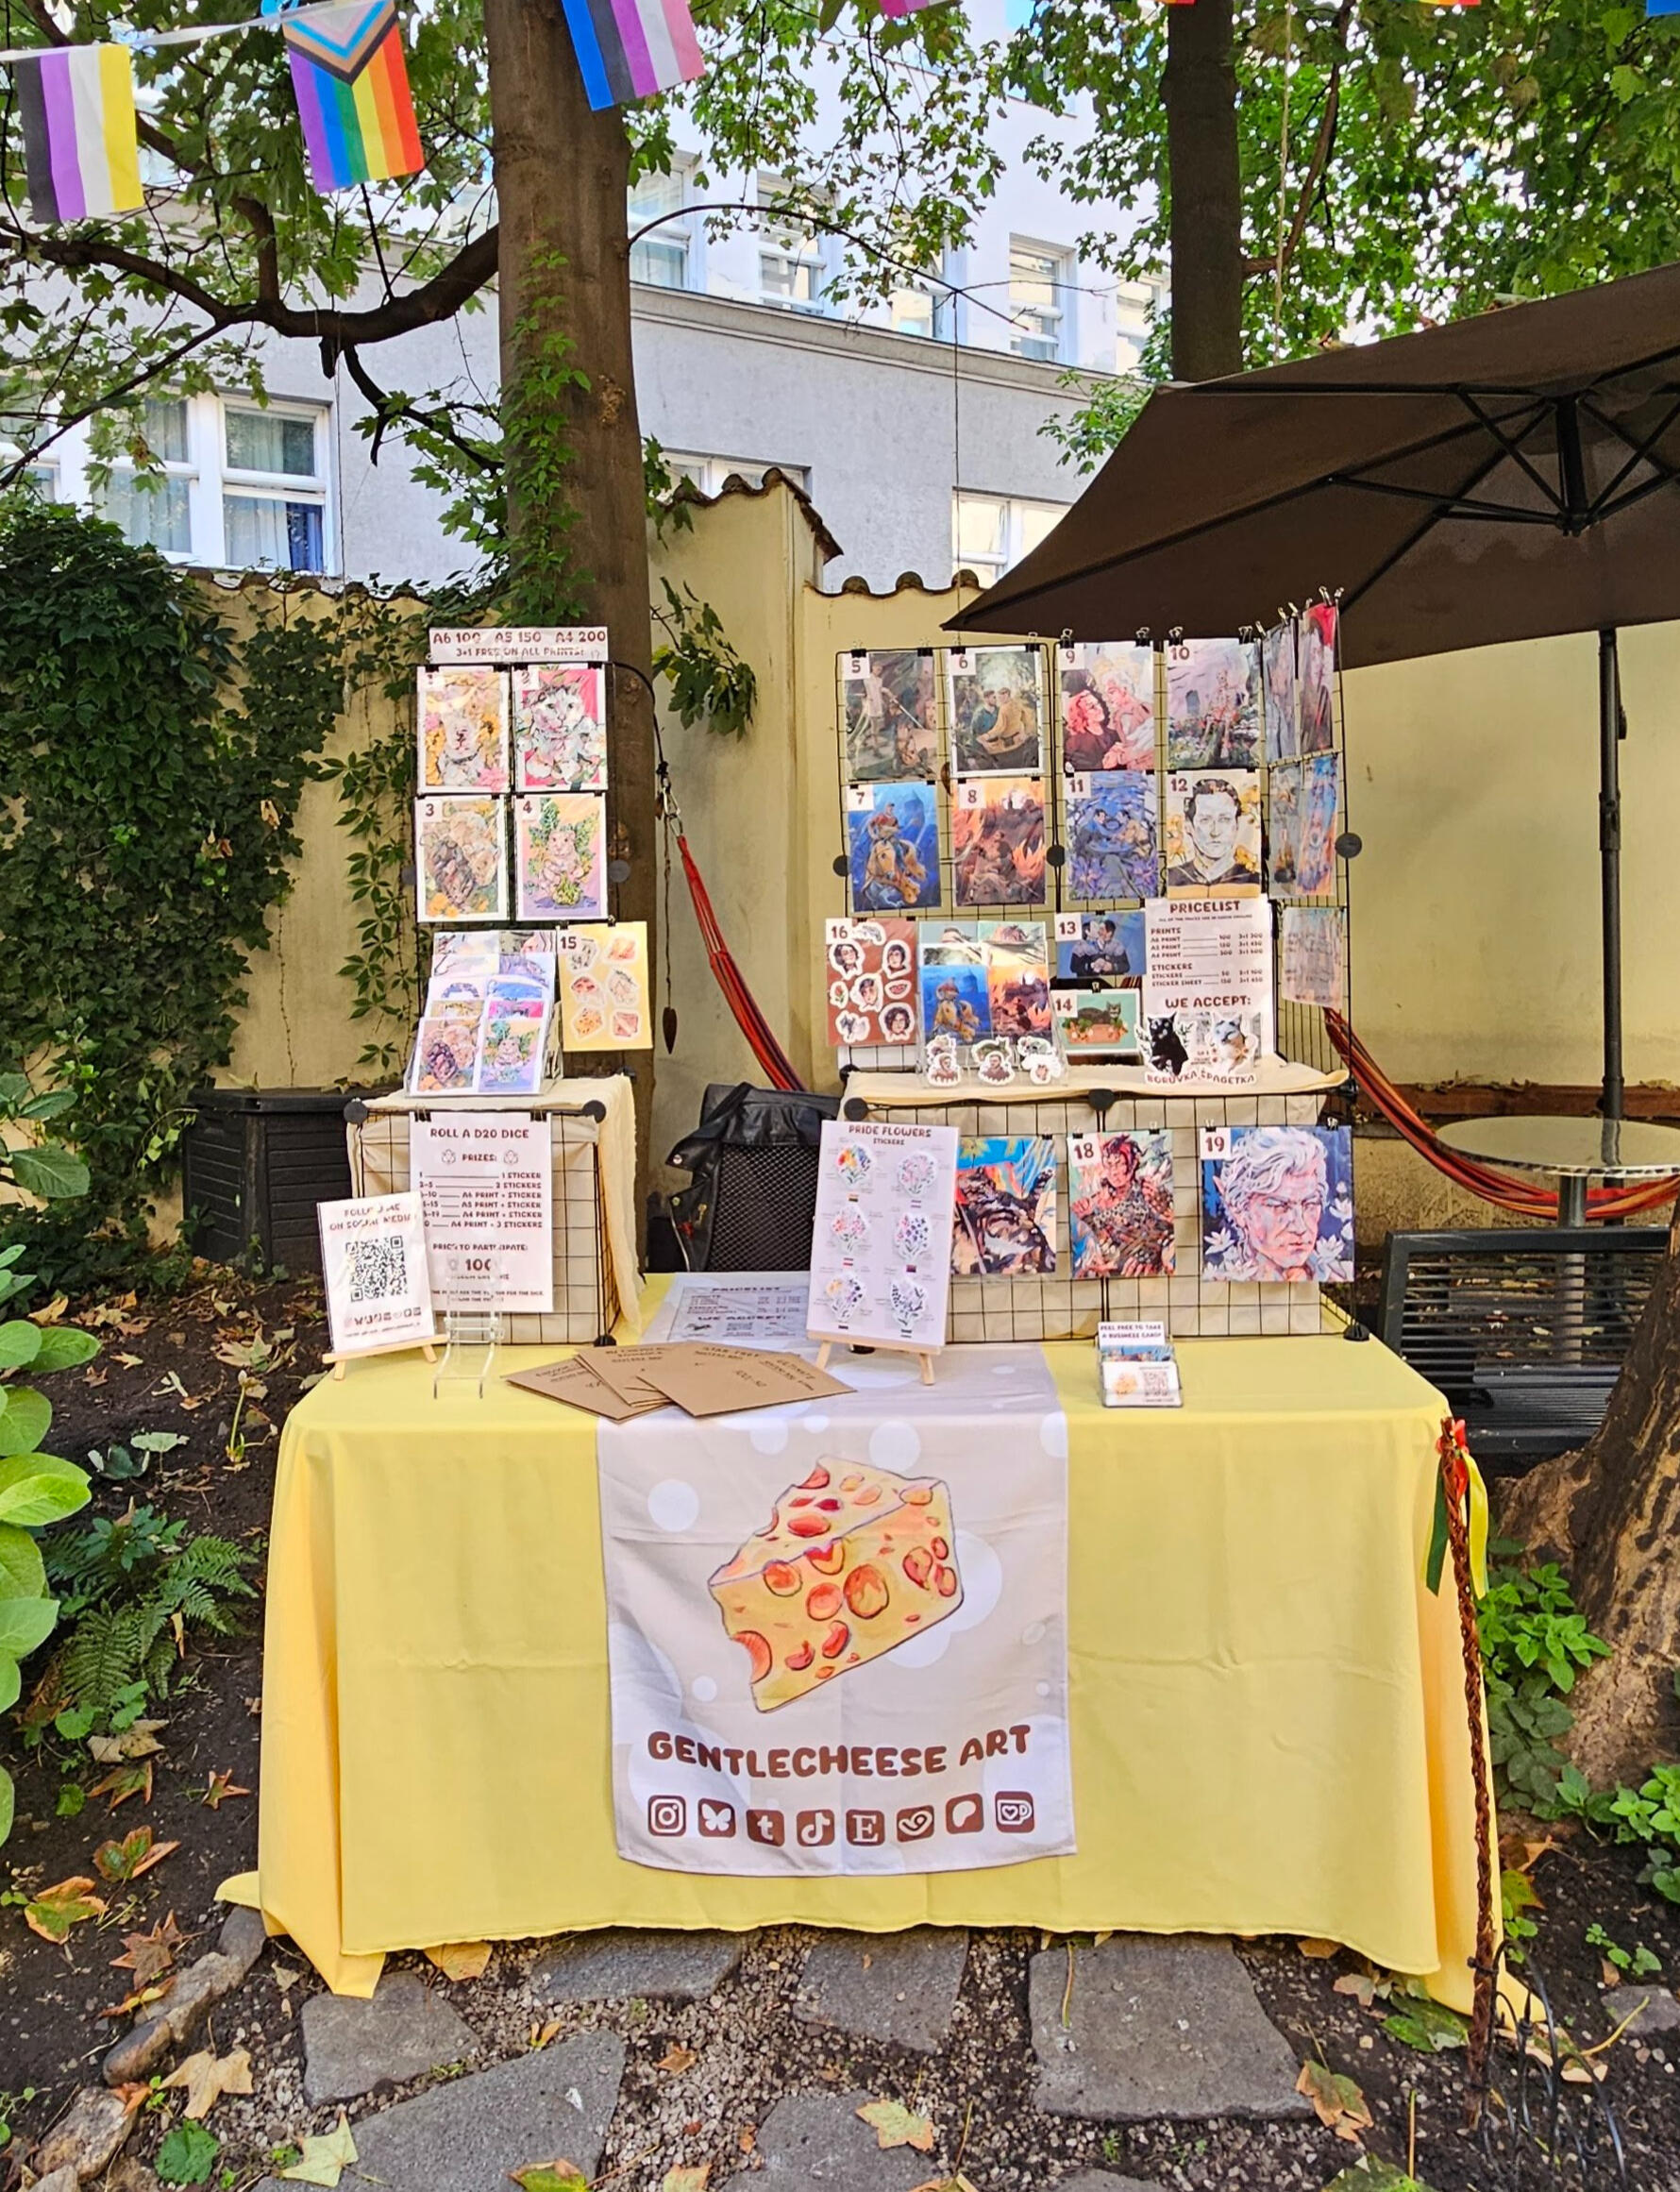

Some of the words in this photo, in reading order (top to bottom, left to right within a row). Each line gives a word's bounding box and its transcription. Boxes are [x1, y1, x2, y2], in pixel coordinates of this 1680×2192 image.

[433, 632, 451, 644] A6
[456, 632, 481, 644] 100
[495, 632, 512, 643] A5
[518, 631, 542, 643] 150
[556, 631, 573, 643] A4
[579, 631, 606, 642] 200
[504, 647, 518, 656] ON
[521, 647, 540, 656] ALL
[1065, 649, 1075, 664] 9
[1169, 646, 1190, 661] 10
[850, 660, 862, 674] 5
[958, 655, 968, 670] 6
[1068, 779, 1084, 793] 11
[1170, 778, 1188, 792] 12
[856, 791, 865, 804] 7
[967, 789, 977, 804] 8
[426, 803, 435, 816] 3
[522, 801, 532, 814] 4
[1169, 901, 1240, 914] PRICELIST
[831, 924, 848, 939] 16
[1059, 921, 1077, 936] 13
[561, 936, 577, 950] 15
[1151, 963, 1193, 971] STICKERS
[1054, 998, 1072, 1012] 14
[1165, 997, 1188, 1008] WE
[1193, 995, 1252, 1007] ACCEPT:
[430, 1128, 459, 1138] ROLL
[462, 1129, 470, 1138] A
[474, 1129, 497, 1138] D20
[501, 1129, 529, 1138] DICE
[848, 1124, 879, 1135] PRIDE
[882, 1126, 932, 1138] FLOWERS
[1073, 1143, 1094, 1159] 18
[1205, 1137, 1224, 1153] 19
[462, 1154, 497, 1162] PRIZES:
[329, 1222, 344, 1231] ON
[647, 1730, 947, 1779] GENTLECHEESE
[959, 1724, 1032, 1767] ART
